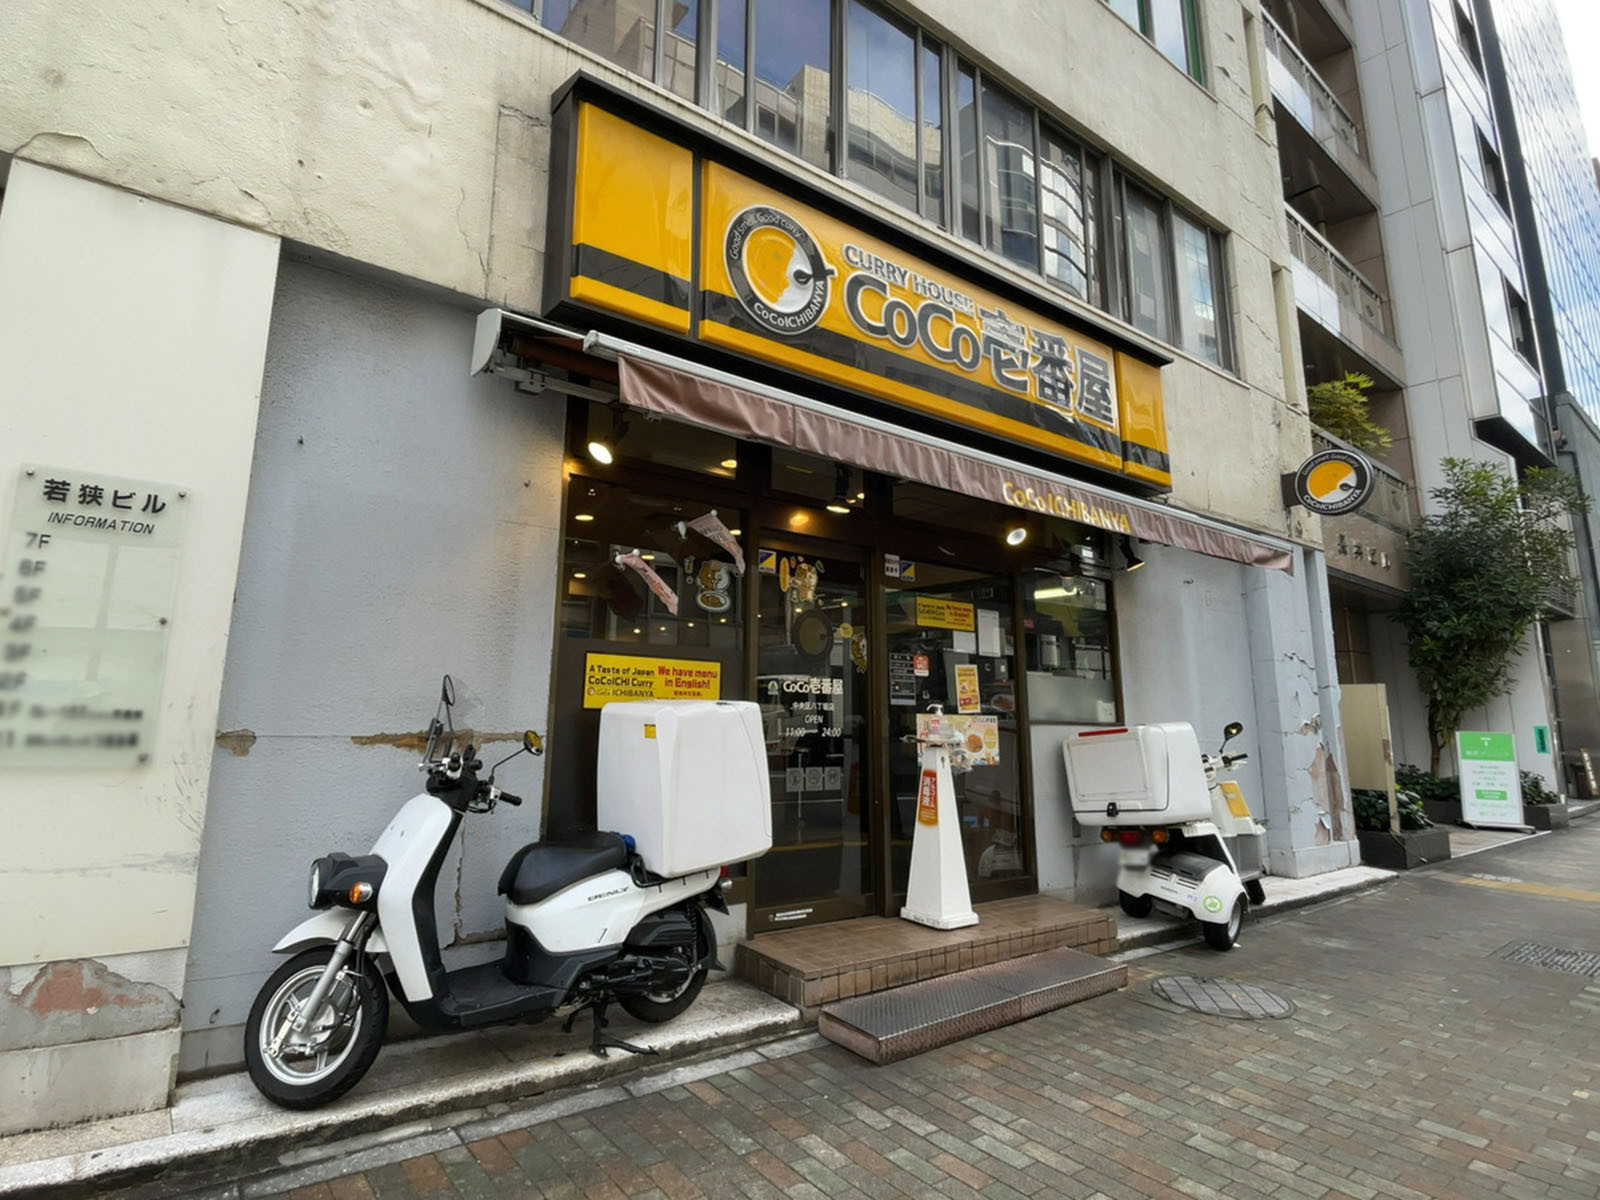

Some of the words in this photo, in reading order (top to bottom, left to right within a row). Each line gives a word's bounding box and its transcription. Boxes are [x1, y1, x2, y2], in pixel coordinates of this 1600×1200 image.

[729, 229, 742, 260] Good
[756, 211, 781, 224] Good
[843, 243, 909, 290] CURRY
[911, 272, 977, 318] HOUSE
[753, 279, 825, 328] CoCoICHIBANYA
[43, 478, 167, 514] 若狭ビル
[48, 511, 156, 535] INFORMATION
[26, 531, 52, 549] 7F
[588, 664, 596, 673] A
[597, 664, 621, 675] Taste
[622, 666, 631, 676] of
[632, 667, 655, 678] Japan
[657, 666, 671, 676] We
[672, 667, 694, 678] have
[695, 670, 718, 679] menu
[631, 678, 653, 689] Curry
[664, 677, 674, 688] in
[675, 678, 711, 690] English!
[804, 714, 824, 724] OPEN
